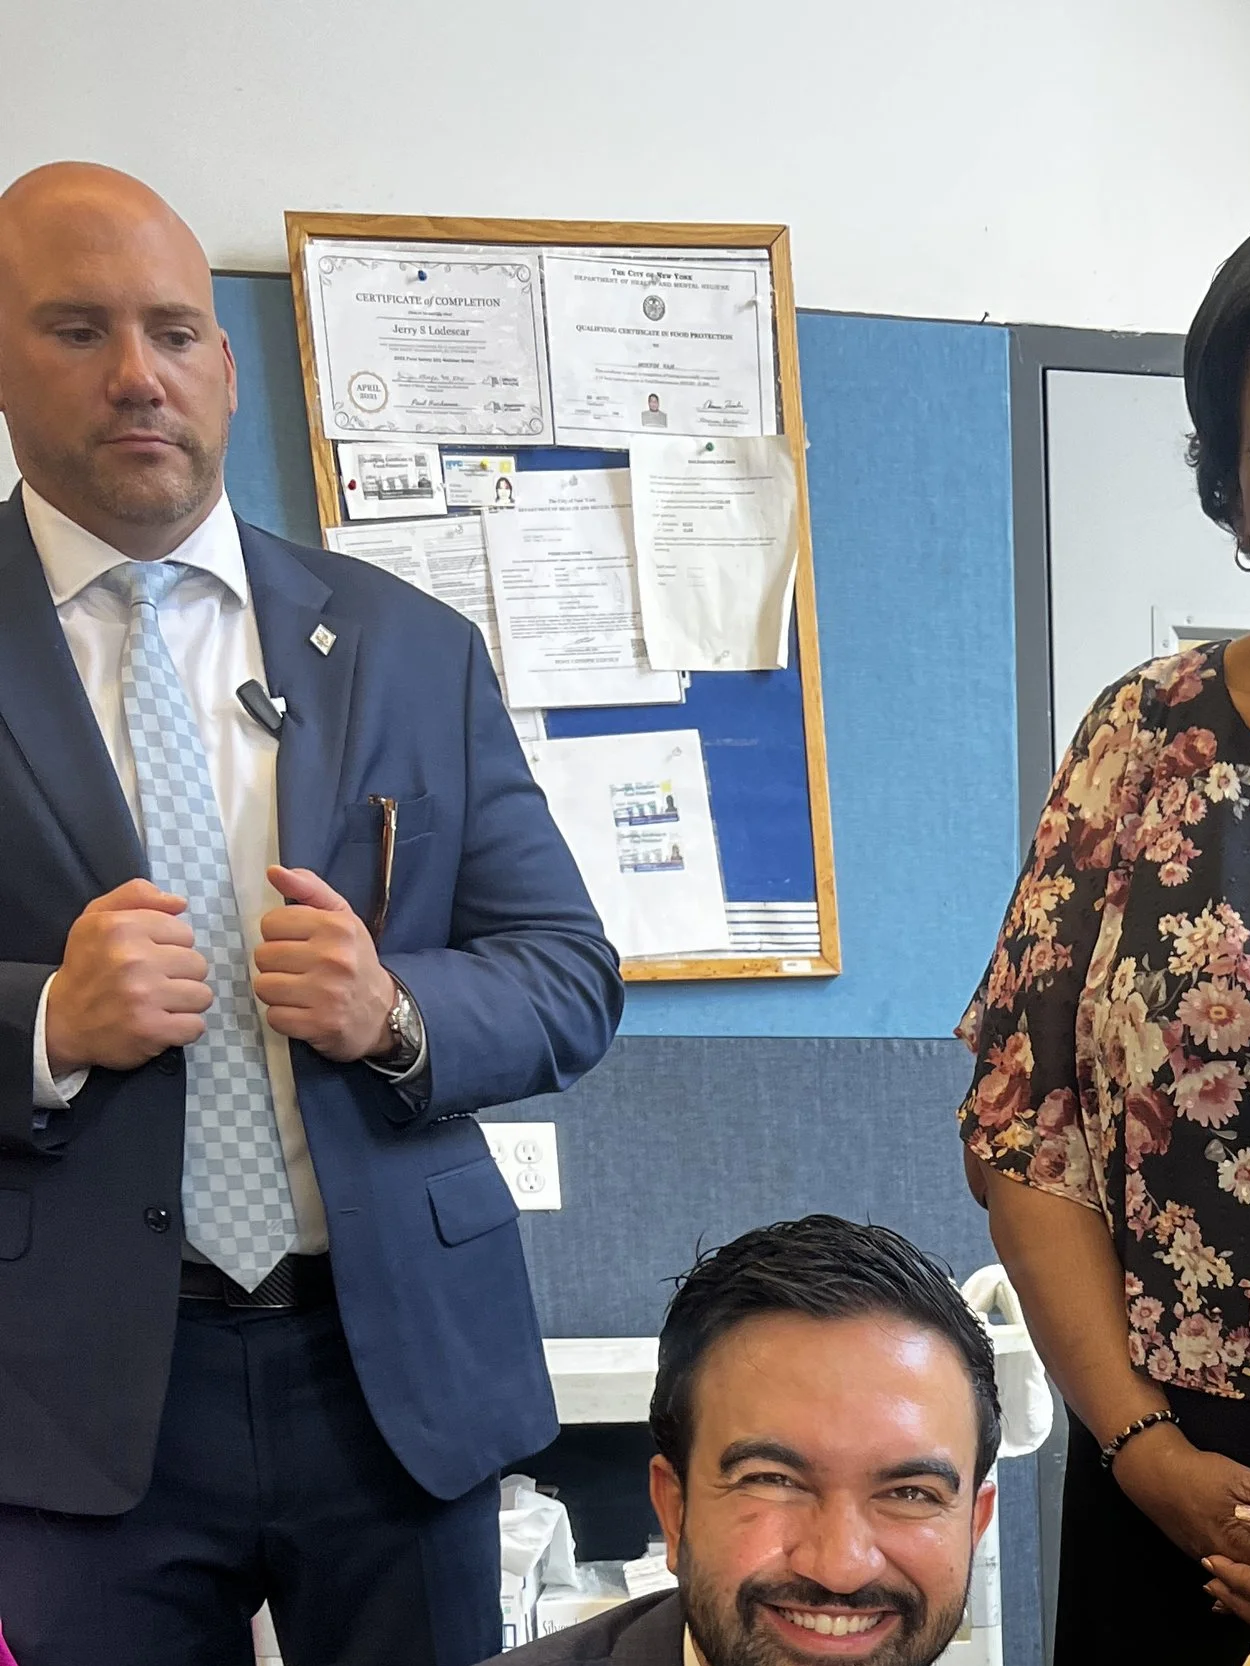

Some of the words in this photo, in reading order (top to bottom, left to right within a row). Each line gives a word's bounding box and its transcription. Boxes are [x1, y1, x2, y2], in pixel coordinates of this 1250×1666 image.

[574, 274, 619, 284] DEPARTMENT
[355, 292, 422, 305] CERTIFICATE
[424, 296, 434, 305] of
[435, 297, 501, 307] COMPLETION
[392, 324, 417, 336] Jerry
[419, 325, 427, 335] S
[575, 324, 618, 334] QUALIFYING
[618, 326, 660, 337] CERTIFICATE
[669, 330, 690, 338] FOOD
[690, 332, 733, 341] PROTECTION
[356, 383, 381, 393] APRIL
